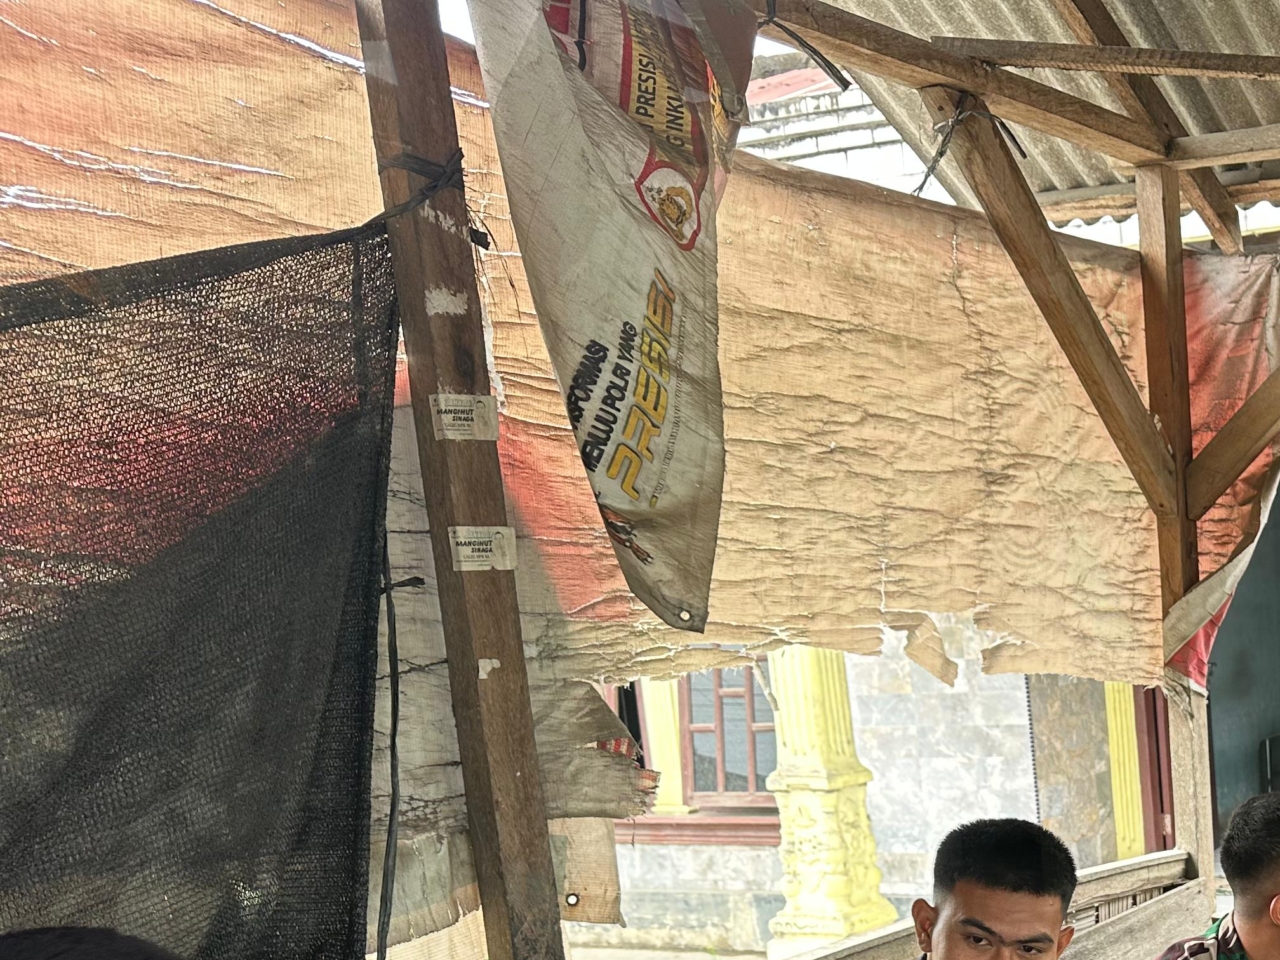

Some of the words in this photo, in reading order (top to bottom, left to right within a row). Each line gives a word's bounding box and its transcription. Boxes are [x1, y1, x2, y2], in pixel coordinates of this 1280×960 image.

[636, 52, 656, 119] PRESISI
[601, 362, 631, 412] POLRI
[617, 320, 637, 364] YANG
[606, 267, 676, 500] PRESISI
